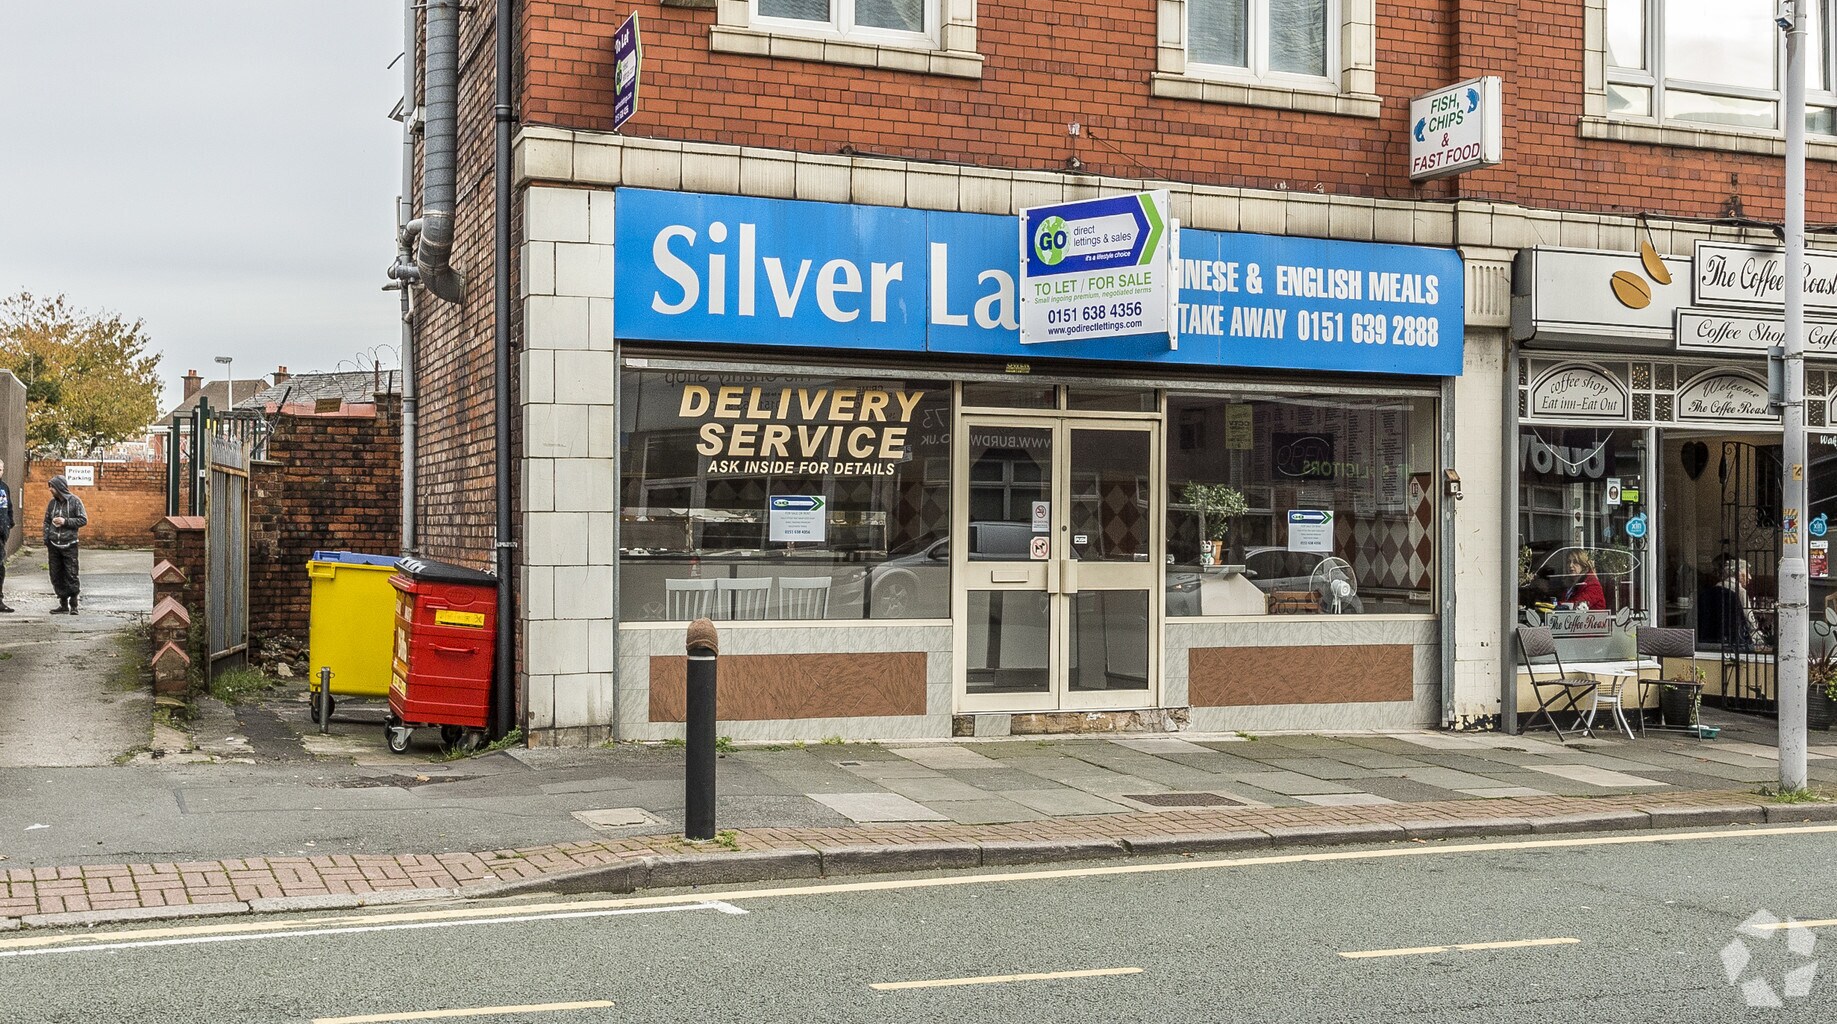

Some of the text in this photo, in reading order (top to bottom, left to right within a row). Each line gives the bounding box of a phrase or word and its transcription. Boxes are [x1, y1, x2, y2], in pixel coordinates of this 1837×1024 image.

[621, 28, 630, 49] Let
[1431, 93, 1460, 114] FISH,
[1429, 110, 1464, 132] CHIPS
[1441, 132, 1450, 148] &
[1413, 142, 1480, 172] FAST FOOD
[1039, 230, 1067, 251] GO
[1073, 225, 1095, 236] direct
[1073, 232, 1132, 247] lettings & sales
[1114, 251, 1131, 259] choice
[651, 221, 1020, 331] Silver La
[1034, 282, 1051, 296] TO
[1055, 280, 1077, 294] LET
[1088, 276, 1115, 291] FOR
[1118, 271, 1152, 288] SALE
[1179, 259, 1439, 305] INESE & ENGLISH MEALS
[1701, 254, 1736, 288] The
[1740, 257, 1785, 297] Coffee
[1034, 296, 1050, 304] Small
[1134, 286, 1152, 294] terms
[1048, 301, 1142, 324] 0151 638 4356
[1048, 319, 1143, 336] www.godirectlettings.com
[1178, 303, 1439, 348] TAKE AWAY 0151 639 2888
[1697, 318, 1741, 344] Coffee
[1550, 372, 1609, 396] coffee shop
[1703, 377, 1760, 398] Welcome
[678, 384, 925, 423] DELIVERY
[1541, 396, 1559, 409] Eat
[1600, 397, 1618, 411] Out
[1726, 391, 1734, 399] to
[1688, 399, 1707, 413] The
[1710, 400, 1736, 416] Coffee
[696, 422, 908, 459] SERVICE
[707, 460, 895, 476] ASK INSIDE FOR DETAILS
[1550, 615, 1563, 631] The
[1564, 615, 1584, 632] Coffee
